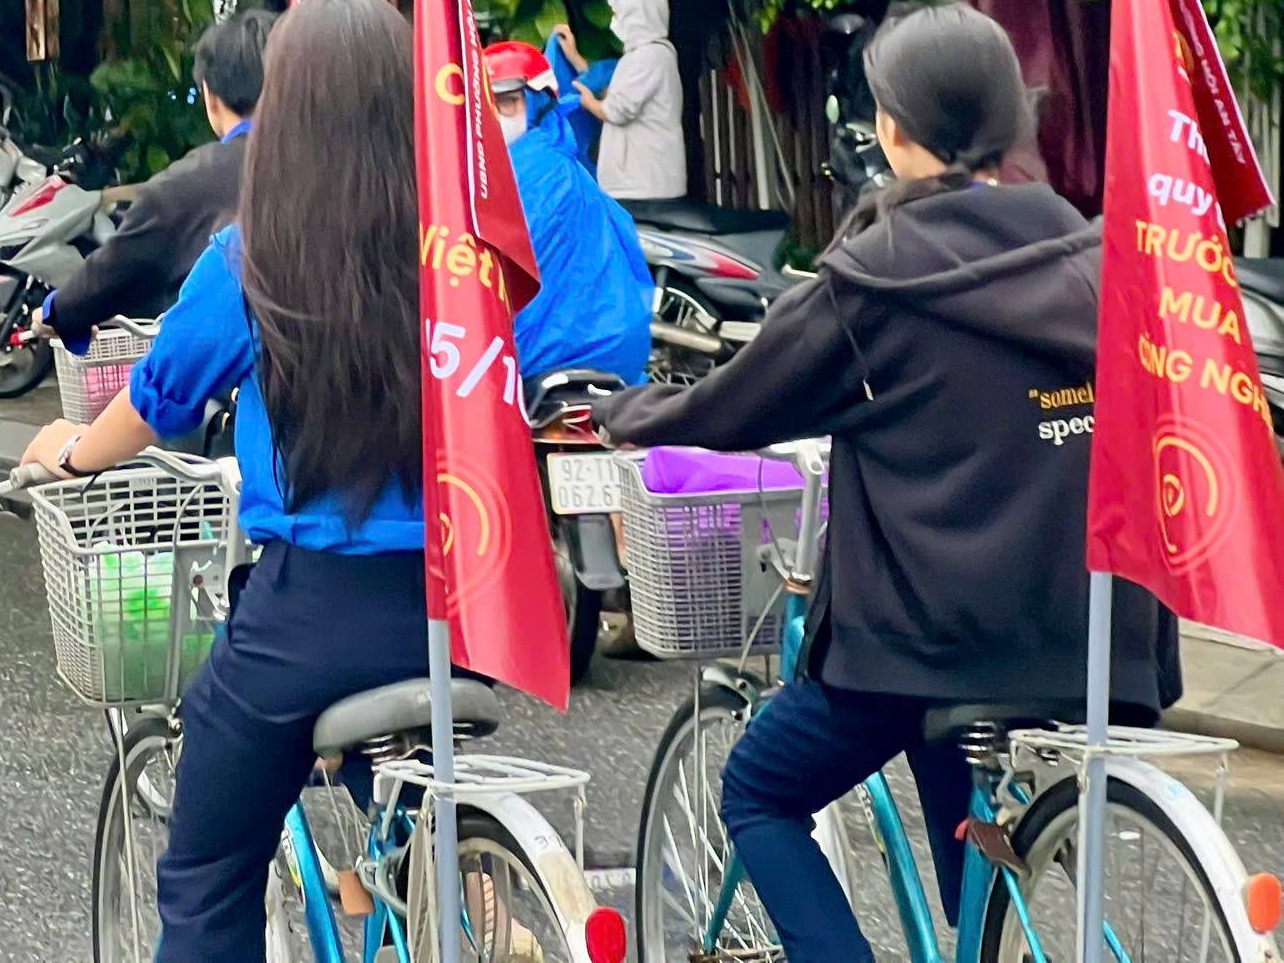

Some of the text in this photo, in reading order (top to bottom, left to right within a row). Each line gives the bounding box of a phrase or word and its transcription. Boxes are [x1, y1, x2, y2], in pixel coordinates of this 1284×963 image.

[477, 140, 489, 200] UBND
[1147, 172, 1213, 217] quy
[1159, 287, 1242, 345] MUA
